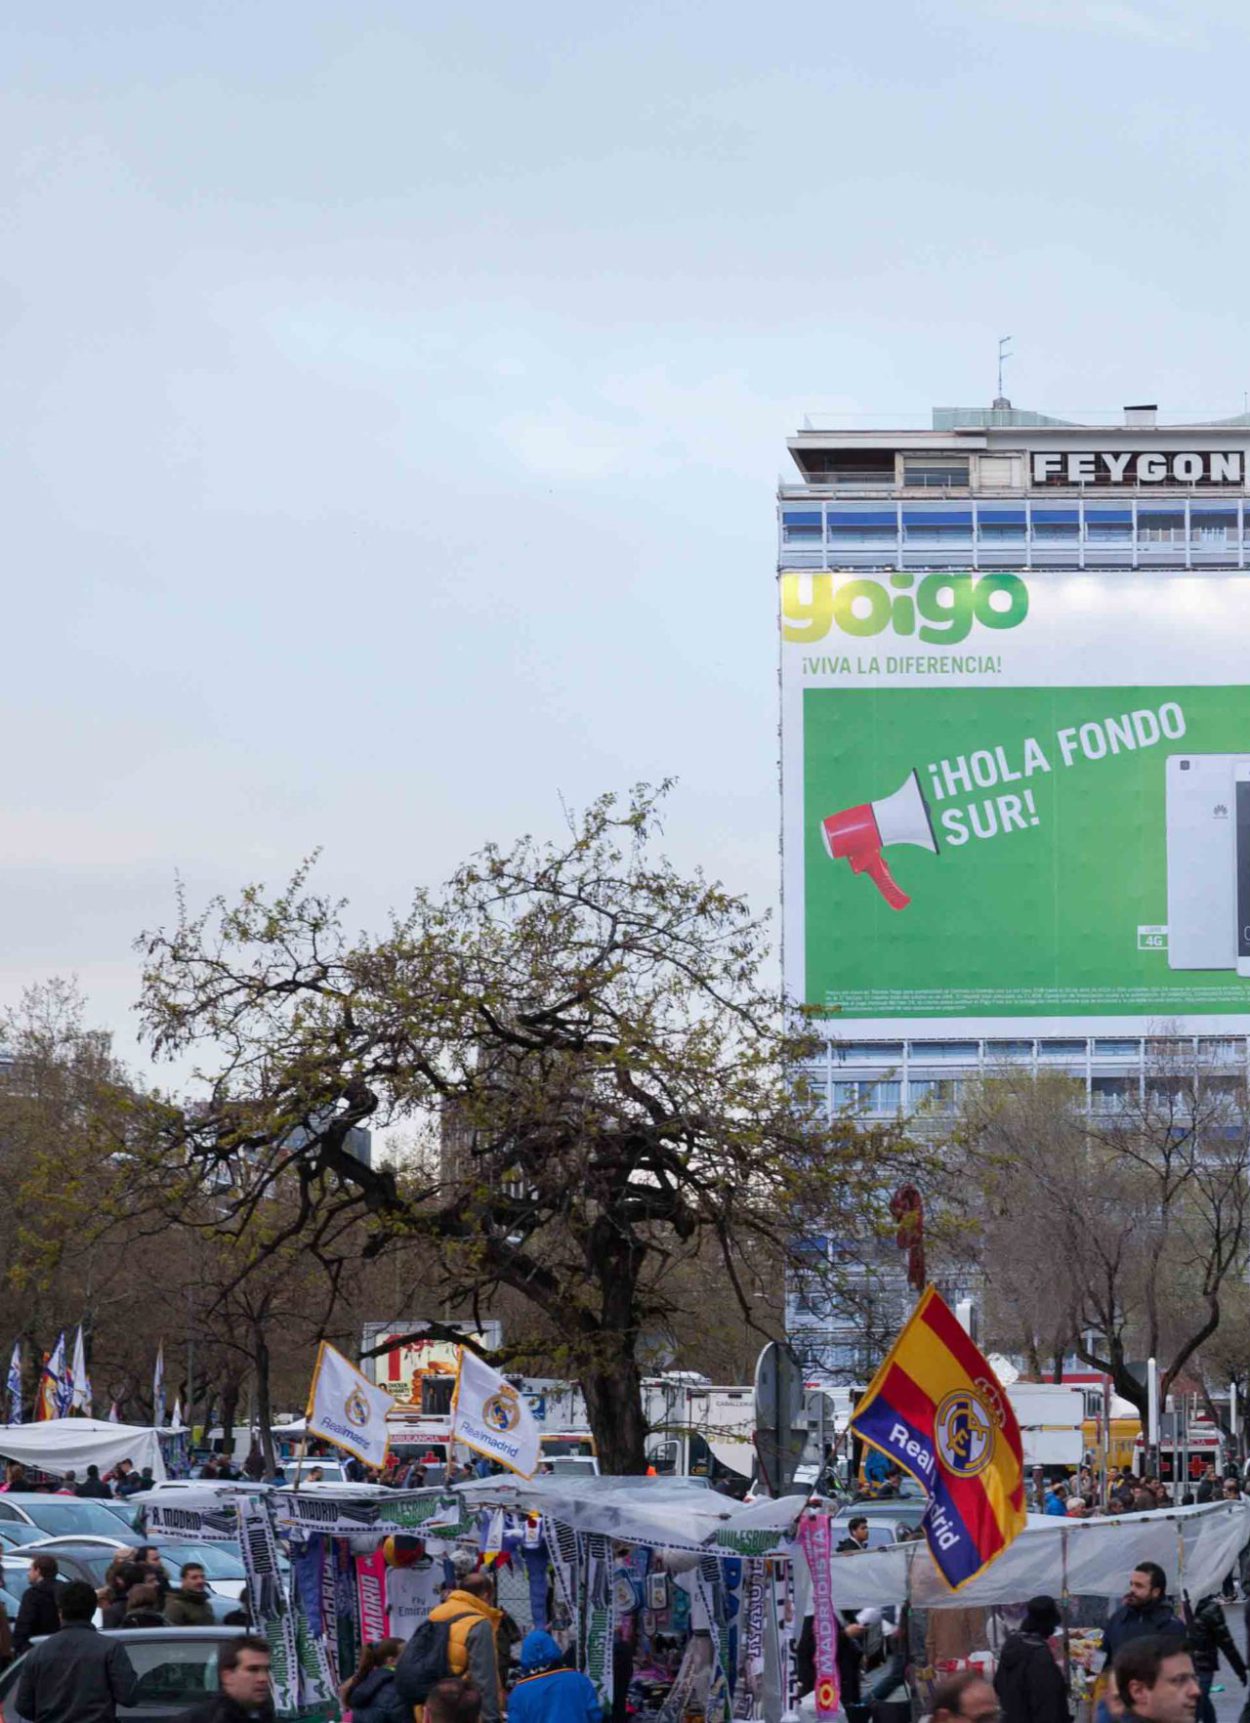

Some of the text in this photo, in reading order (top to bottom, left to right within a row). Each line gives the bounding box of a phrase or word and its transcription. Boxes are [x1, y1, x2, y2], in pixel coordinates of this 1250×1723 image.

[1034, 453, 1240, 482] FEYGON
[783, 573, 1029, 645] yoigo
[802, 655, 1002, 674] ¡VIVA LA DIFERENCIA!
[928, 702, 1187, 800] ¡HOLA FONDO
[941, 789, 1040, 846] SUR!
[1146, 936, 1163, 945] 4G
[889, 1423, 935, 1475] Real
[163, 1508, 200, 1530] MADRID
[299, 1501, 338, 1522] MADRID
[249, 1528, 273, 1575] MADRID
[361, 1575, 385, 1642] MADRID
[411, 1596, 426, 1605] Fly
[813, 1528, 833, 1674] MADRIDISTA
